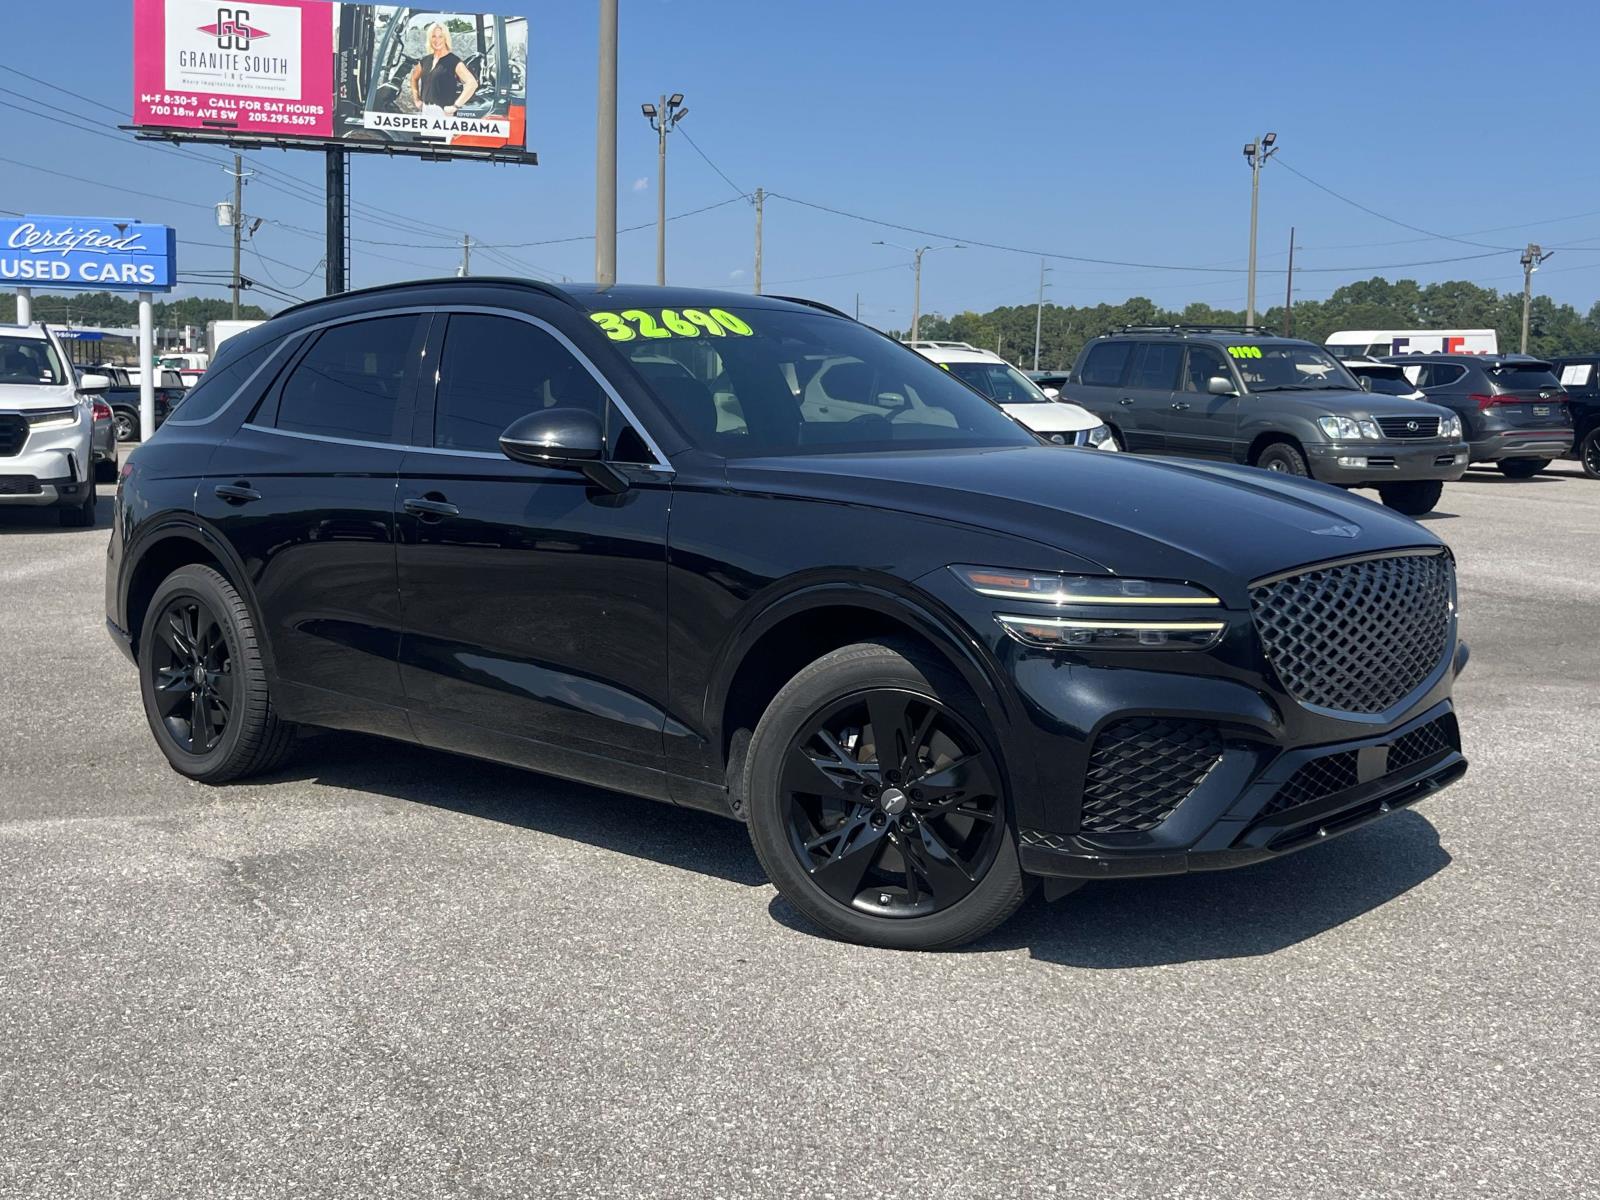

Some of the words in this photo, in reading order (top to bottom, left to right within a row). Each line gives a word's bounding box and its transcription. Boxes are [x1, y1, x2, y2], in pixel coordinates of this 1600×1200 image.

[217, 8, 250, 51] GS
[180, 50, 239, 71] GRANITE
[244, 55, 288, 75] SOUTH
[224, 73, 244, 81] INC
[141, 94, 161, 103] M-F
[163, 95, 198, 106] 8:30-5
[209, 98, 237, 109] CALL
[239, 100, 261, 111] FOR
[263, 102, 284, 112] SAT
[286, 103, 324, 115] HOURS
[150, 105, 170, 115] 700
[196, 108, 219, 119] AVE
[220, 110, 238, 120] SW
[248, 112, 316, 125] 205.295.5675
[373, 115, 429, 129] JASPER
[432, 118, 501, 134] ALABAMA
[8, 223, 147, 257] Certified
[0, 259, 71, 280] USED
[79, 262, 156, 283] CARS
[589, 308, 754, 342] 32690
